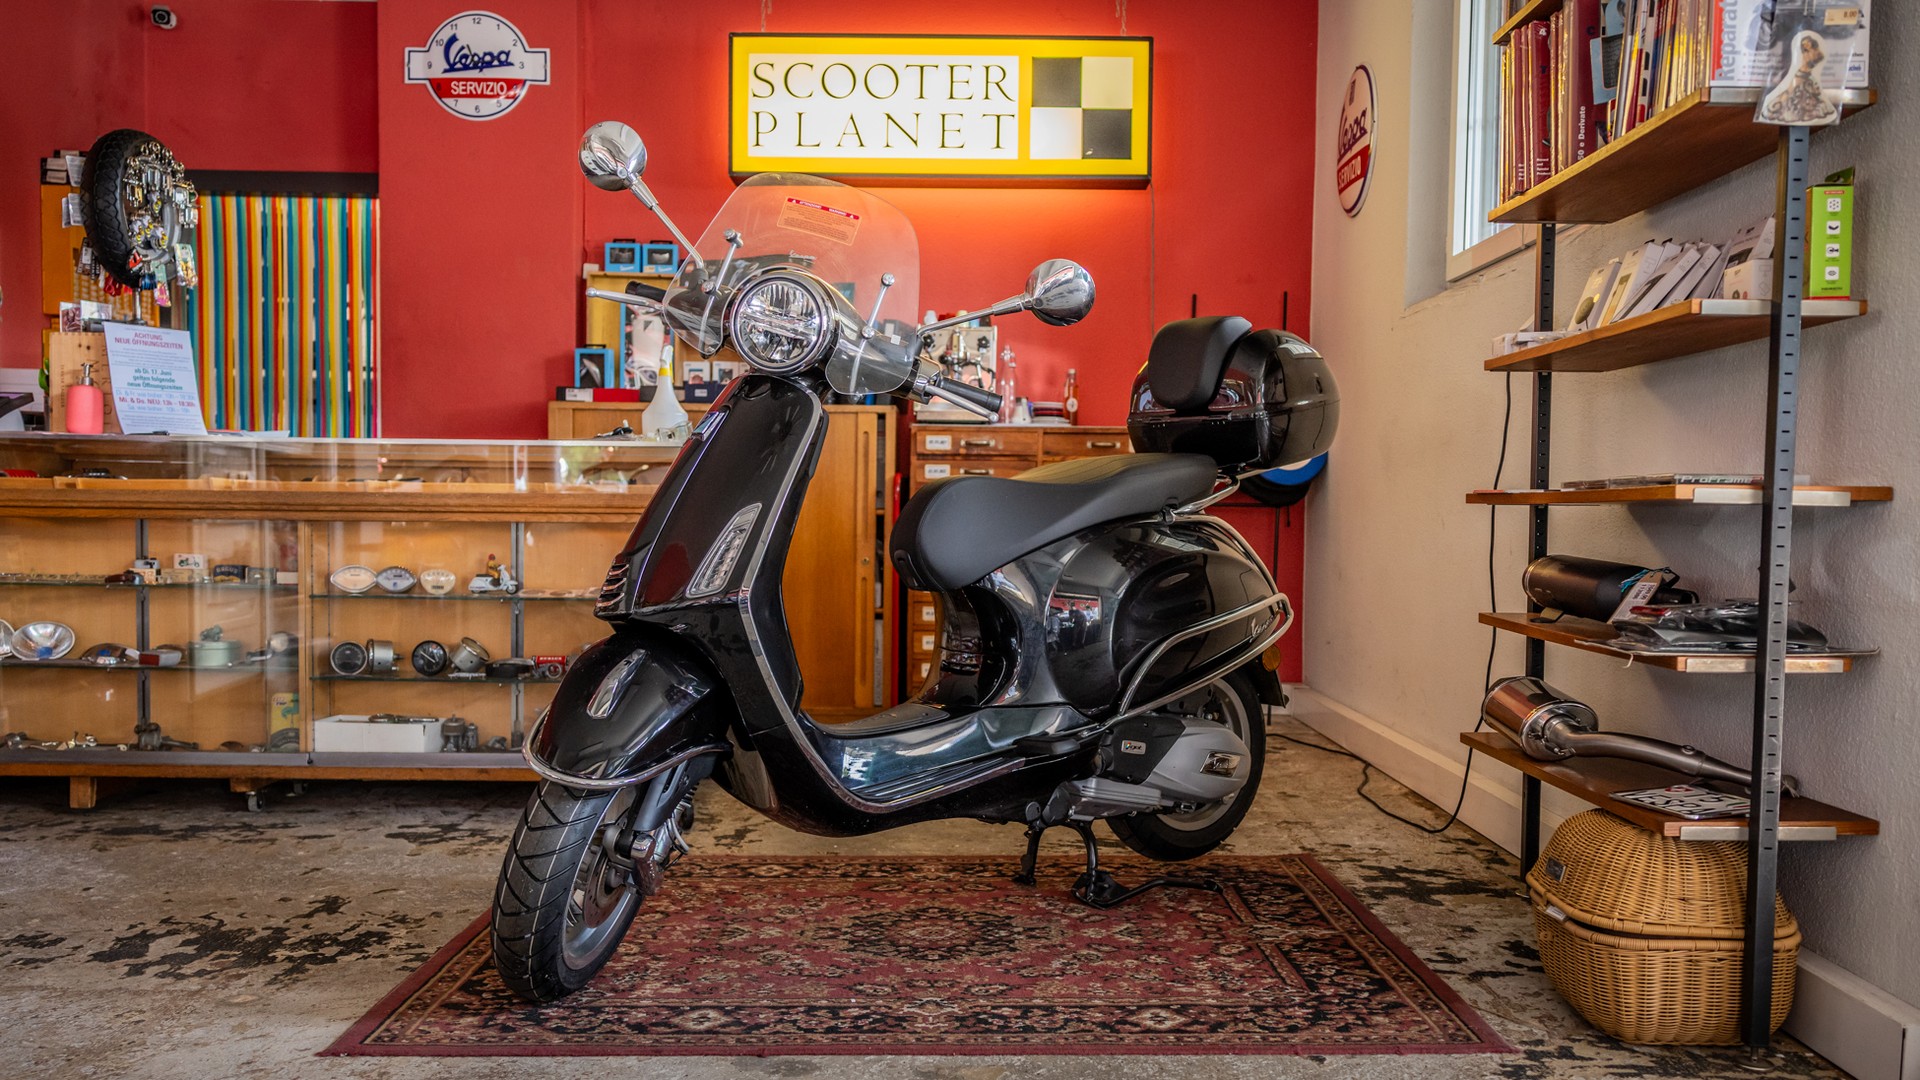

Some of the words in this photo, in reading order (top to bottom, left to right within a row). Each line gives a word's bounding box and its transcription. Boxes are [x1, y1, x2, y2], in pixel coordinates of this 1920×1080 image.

[472, 17, 482, 25] 12
[441, 33, 515, 74] Vespa
[450, 81, 507, 95] SERVIZIO
[751, 62, 1016, 102] SCOOTER
[454, 99, 459, 107] 7
[474, 105, 480, 113] 6
[1578, 105, 1586, 140] Derivate
[752, 110, 1016, 150] PLANET
[134, 332, 163, 340] ACHTUNG
[114, 337, 131, 345] NEUE
[131, 338, 184, 350] ÖFFNUNGSZEITEN
